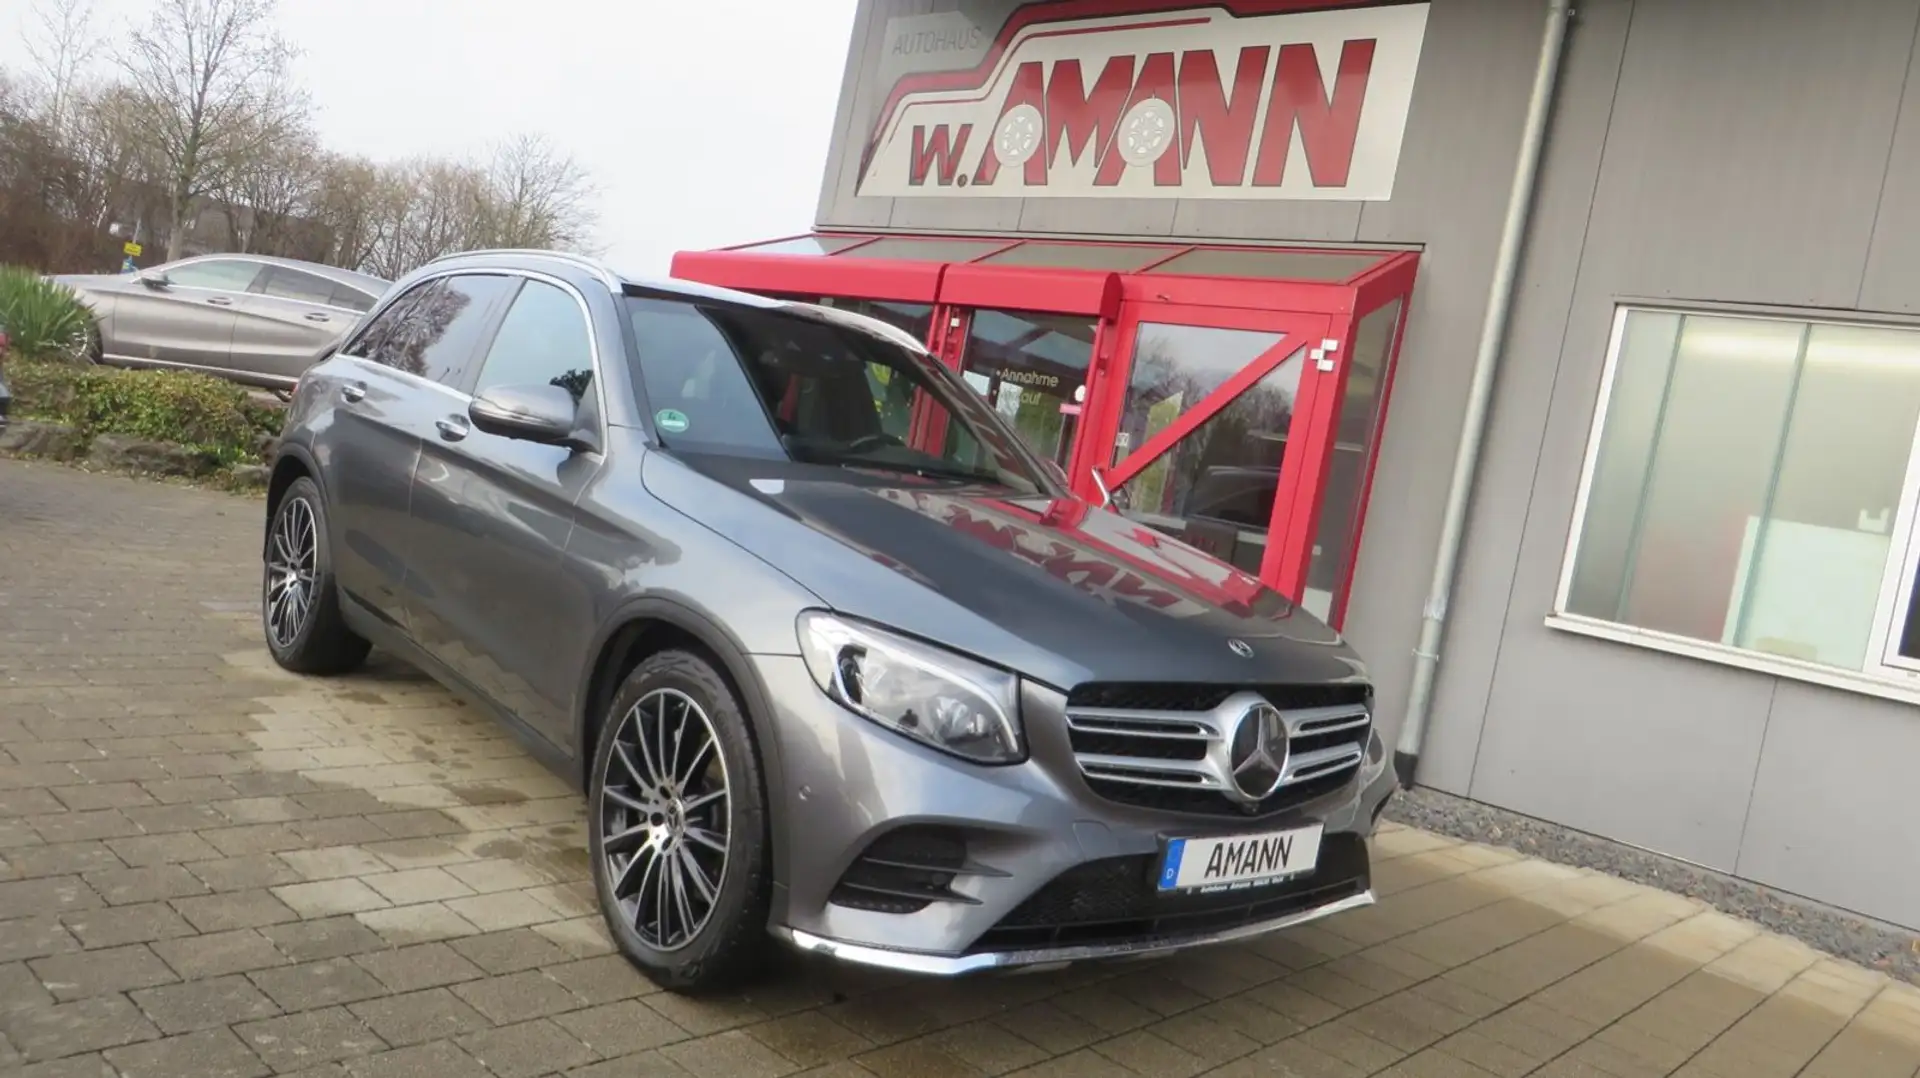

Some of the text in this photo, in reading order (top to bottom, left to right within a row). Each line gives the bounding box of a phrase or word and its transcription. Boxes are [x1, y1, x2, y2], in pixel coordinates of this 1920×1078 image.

[892, 26, 982, 55] AUTOHAUS
[1000, 368, 1059, 388] Annahme
[1204, 835, 1293, 879] AMANN
[1165, 868, 1174, 880] D
